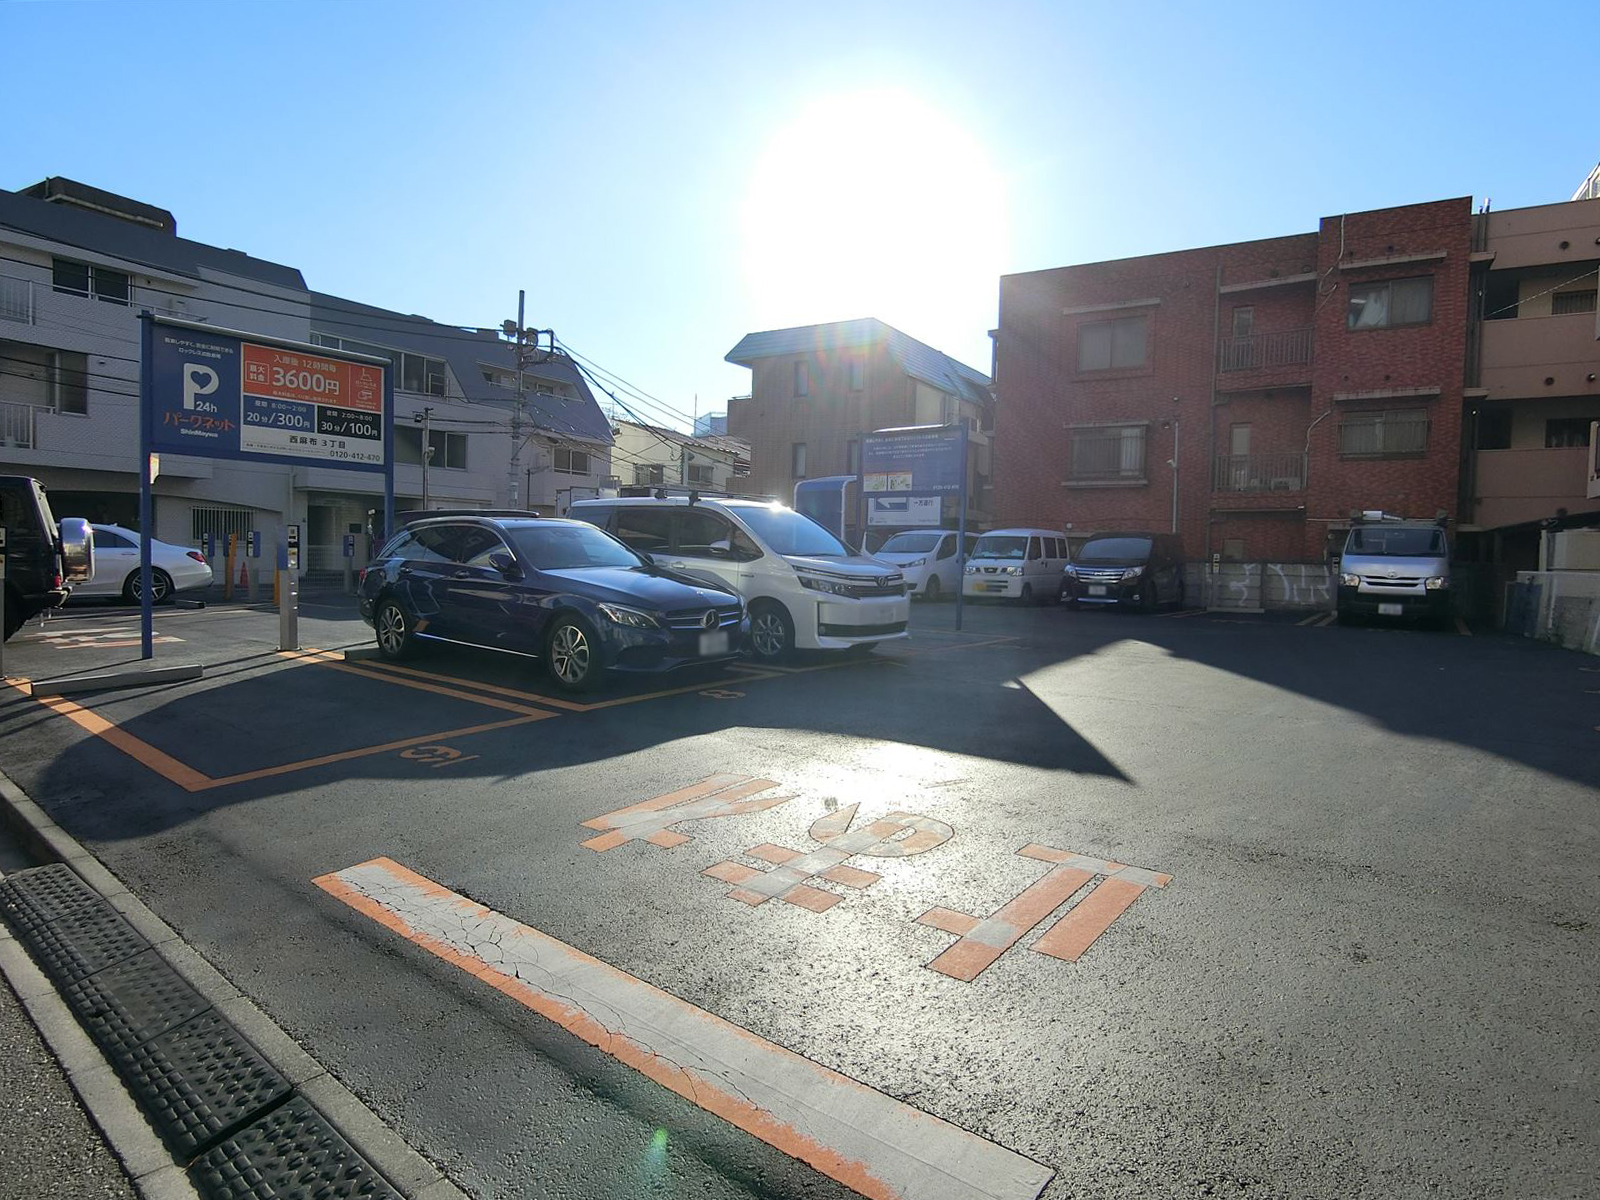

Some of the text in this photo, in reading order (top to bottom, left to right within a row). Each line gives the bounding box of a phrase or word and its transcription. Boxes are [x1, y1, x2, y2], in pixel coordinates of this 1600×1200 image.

[249, 363, 265, 374] 最大
[272, 366, 340, 396] 3600円
[195, 401, 218, 413] 24h
[163, 411, 236, 432] パークネット
[329, 450, 381, 462] 0120-412-470
